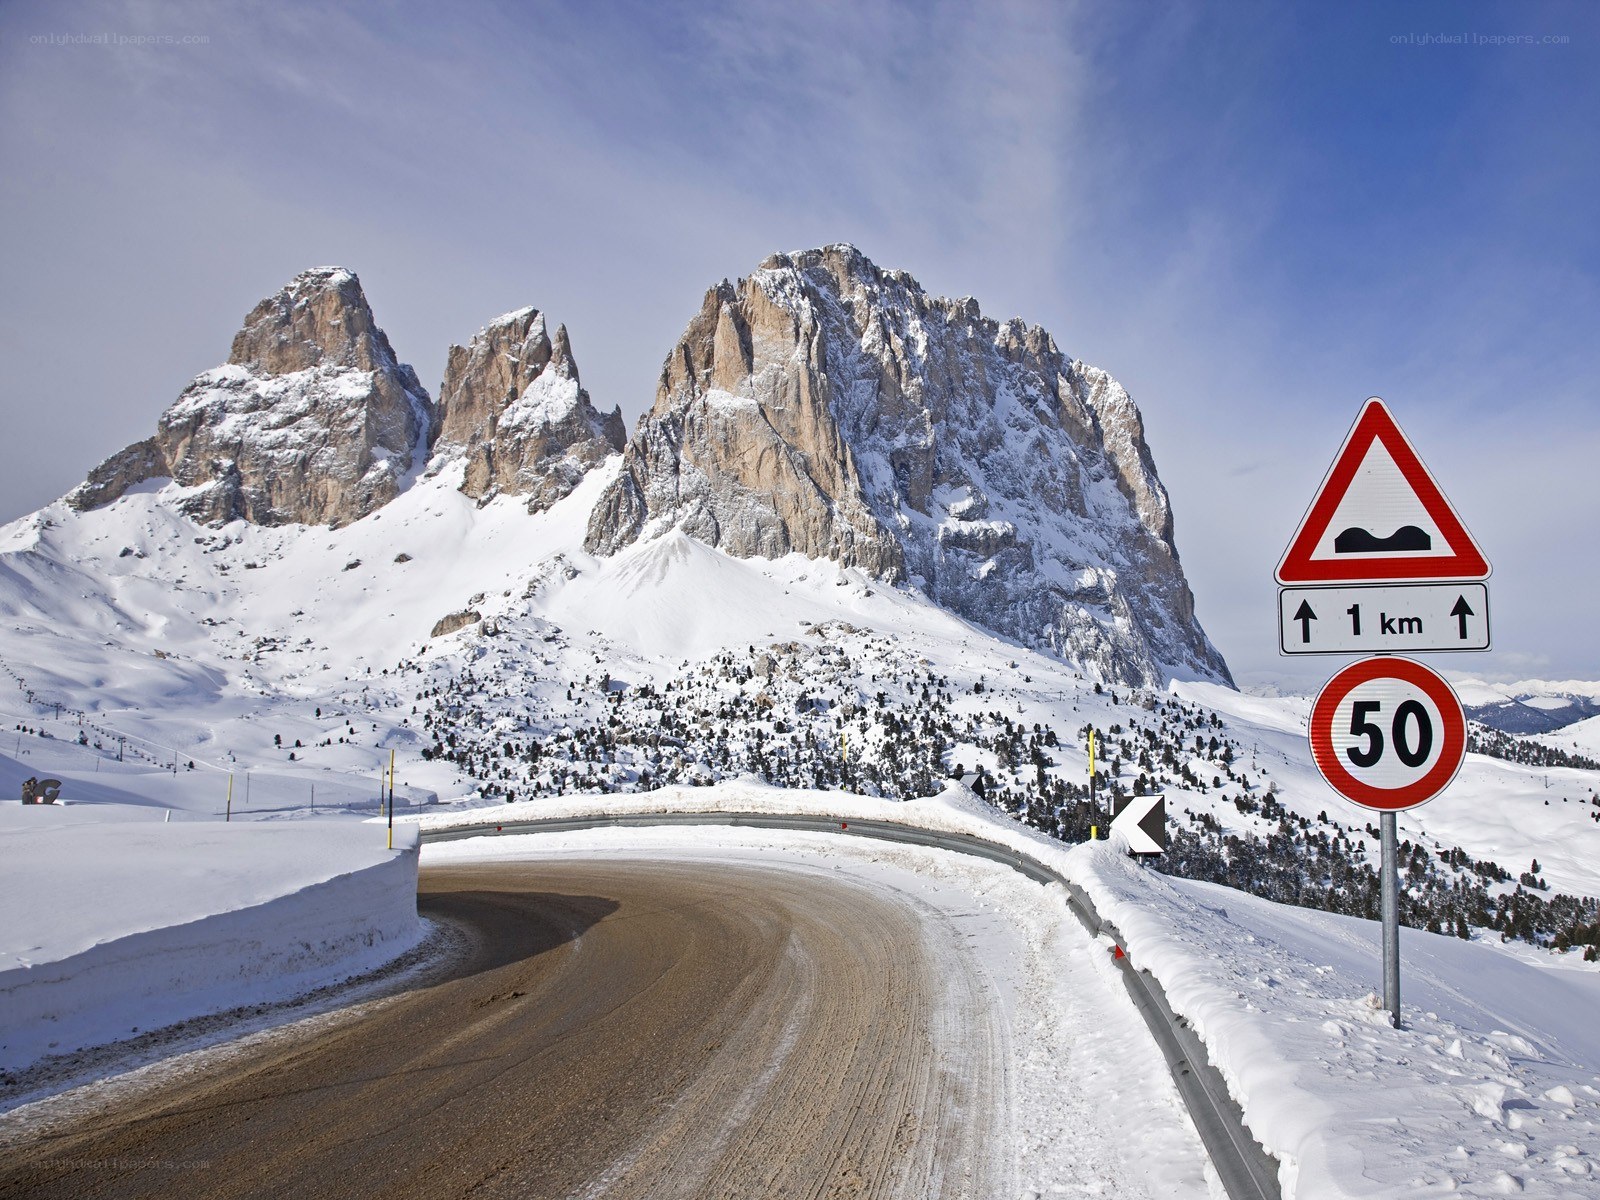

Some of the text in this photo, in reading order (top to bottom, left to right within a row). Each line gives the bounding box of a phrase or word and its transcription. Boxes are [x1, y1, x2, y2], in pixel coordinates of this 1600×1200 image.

[1346, 603, 1424, 636] 1 km
[1346, 699, 1433, 768] 50
